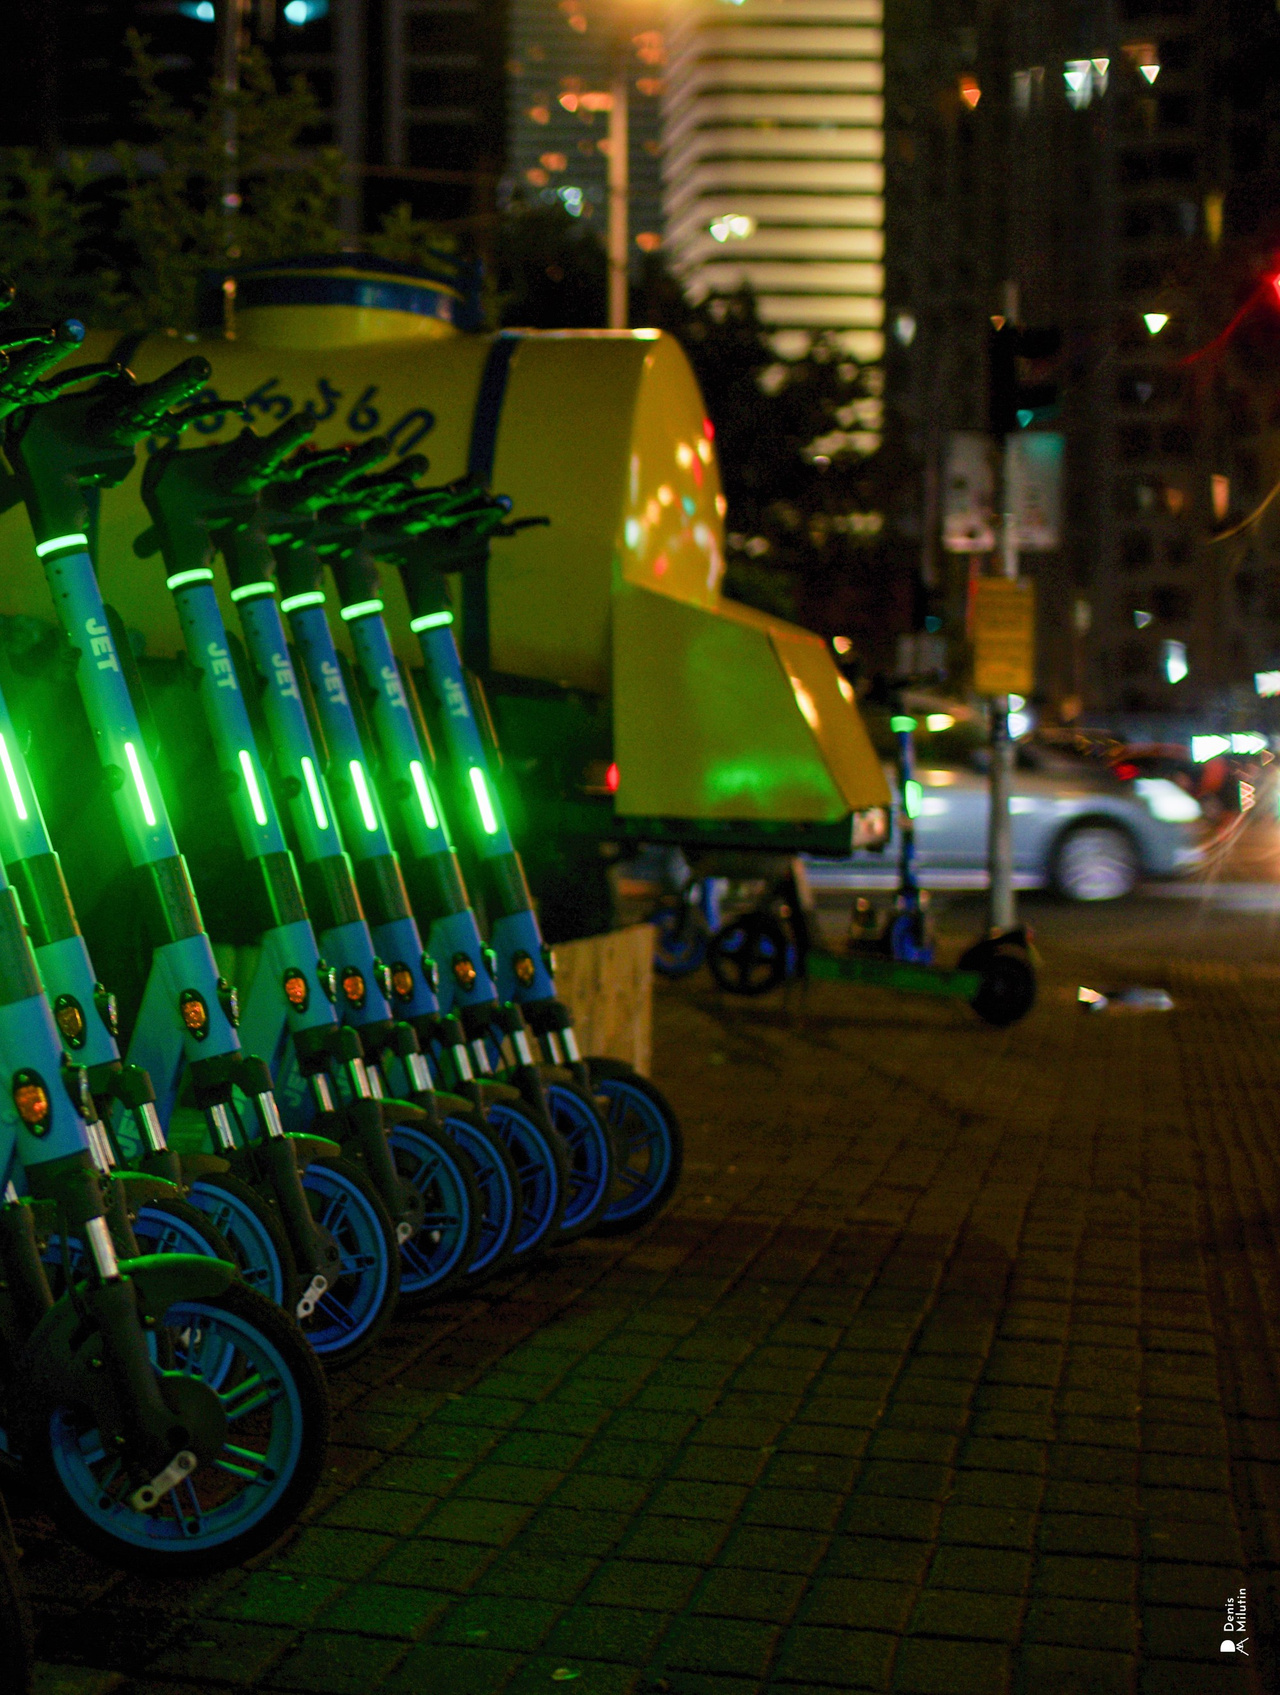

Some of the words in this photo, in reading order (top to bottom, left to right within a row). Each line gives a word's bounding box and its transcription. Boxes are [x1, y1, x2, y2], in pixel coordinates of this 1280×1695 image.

[85, 617, 119, 672] JET
[207, 641, 238, 690] JET
[271, 652, 299, 699] JET
[321, 661, 348, 706] JET
[381, 665, 407, 708] JET
[443, 677, 469, 718] JET
